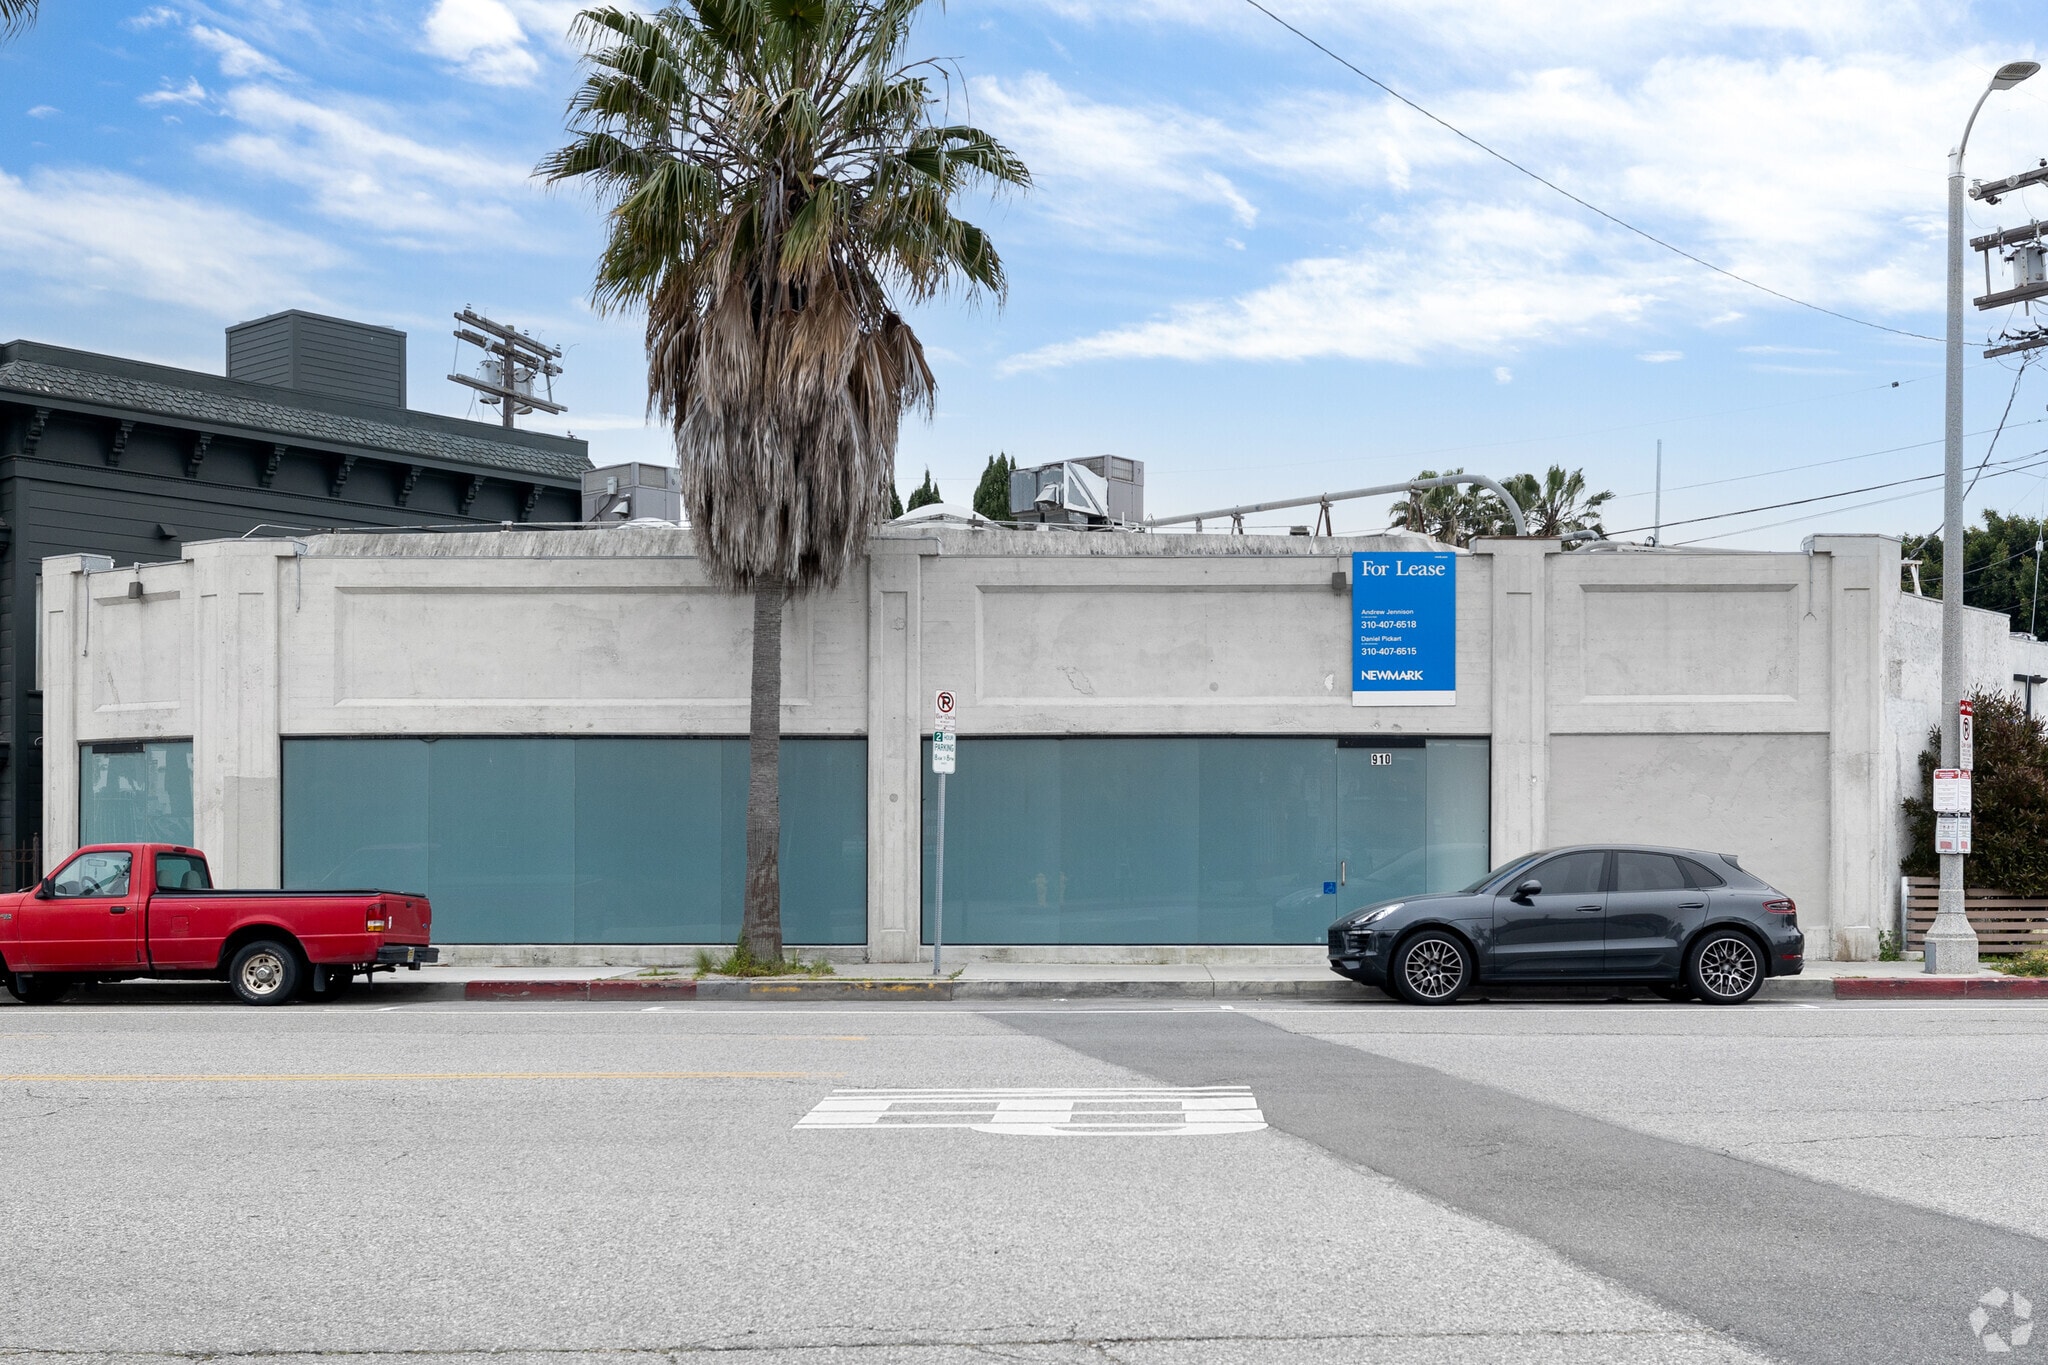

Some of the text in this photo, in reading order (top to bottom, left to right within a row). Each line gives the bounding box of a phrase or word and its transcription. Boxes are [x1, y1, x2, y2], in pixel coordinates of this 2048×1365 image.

[1361, 560, 1446, 576] For Lease
[1361, 620, 1417, 629] 310-407-6518
[1361, 647, 1417, 656] 310-407-6515
[1361, 670, 1424, 681] NEWMARK
[935, 732, 942, 742] 2
[935, 743, 954, 752] PARKING
[1372, 754, 1391, 765] 910
